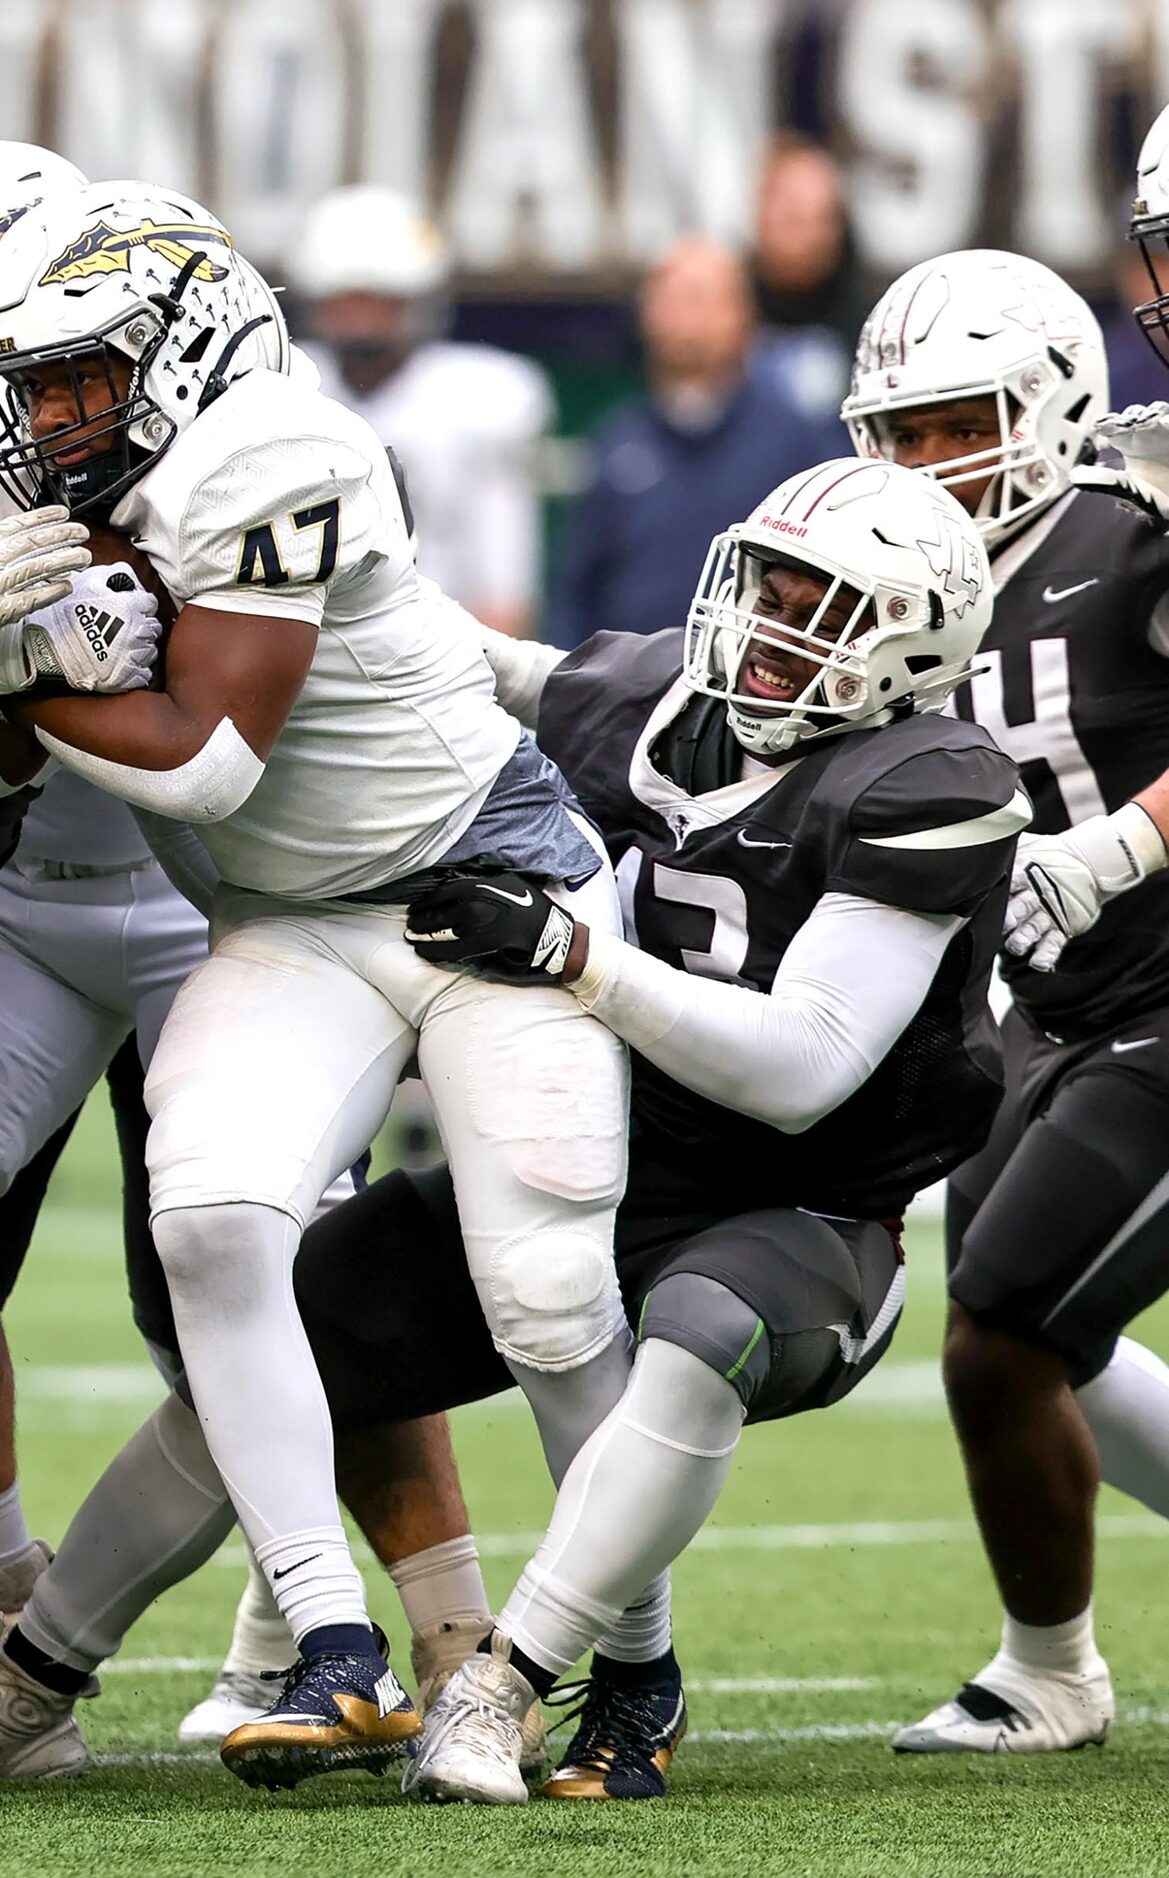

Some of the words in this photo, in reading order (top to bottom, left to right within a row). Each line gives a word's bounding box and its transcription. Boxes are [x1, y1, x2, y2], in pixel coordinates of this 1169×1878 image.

[838, 0, 1169, 268] ST
[236, 495, 342, 588] 47
[759, 515, 808, 538] Riddell
[74, 604, 108, 662] adidas
